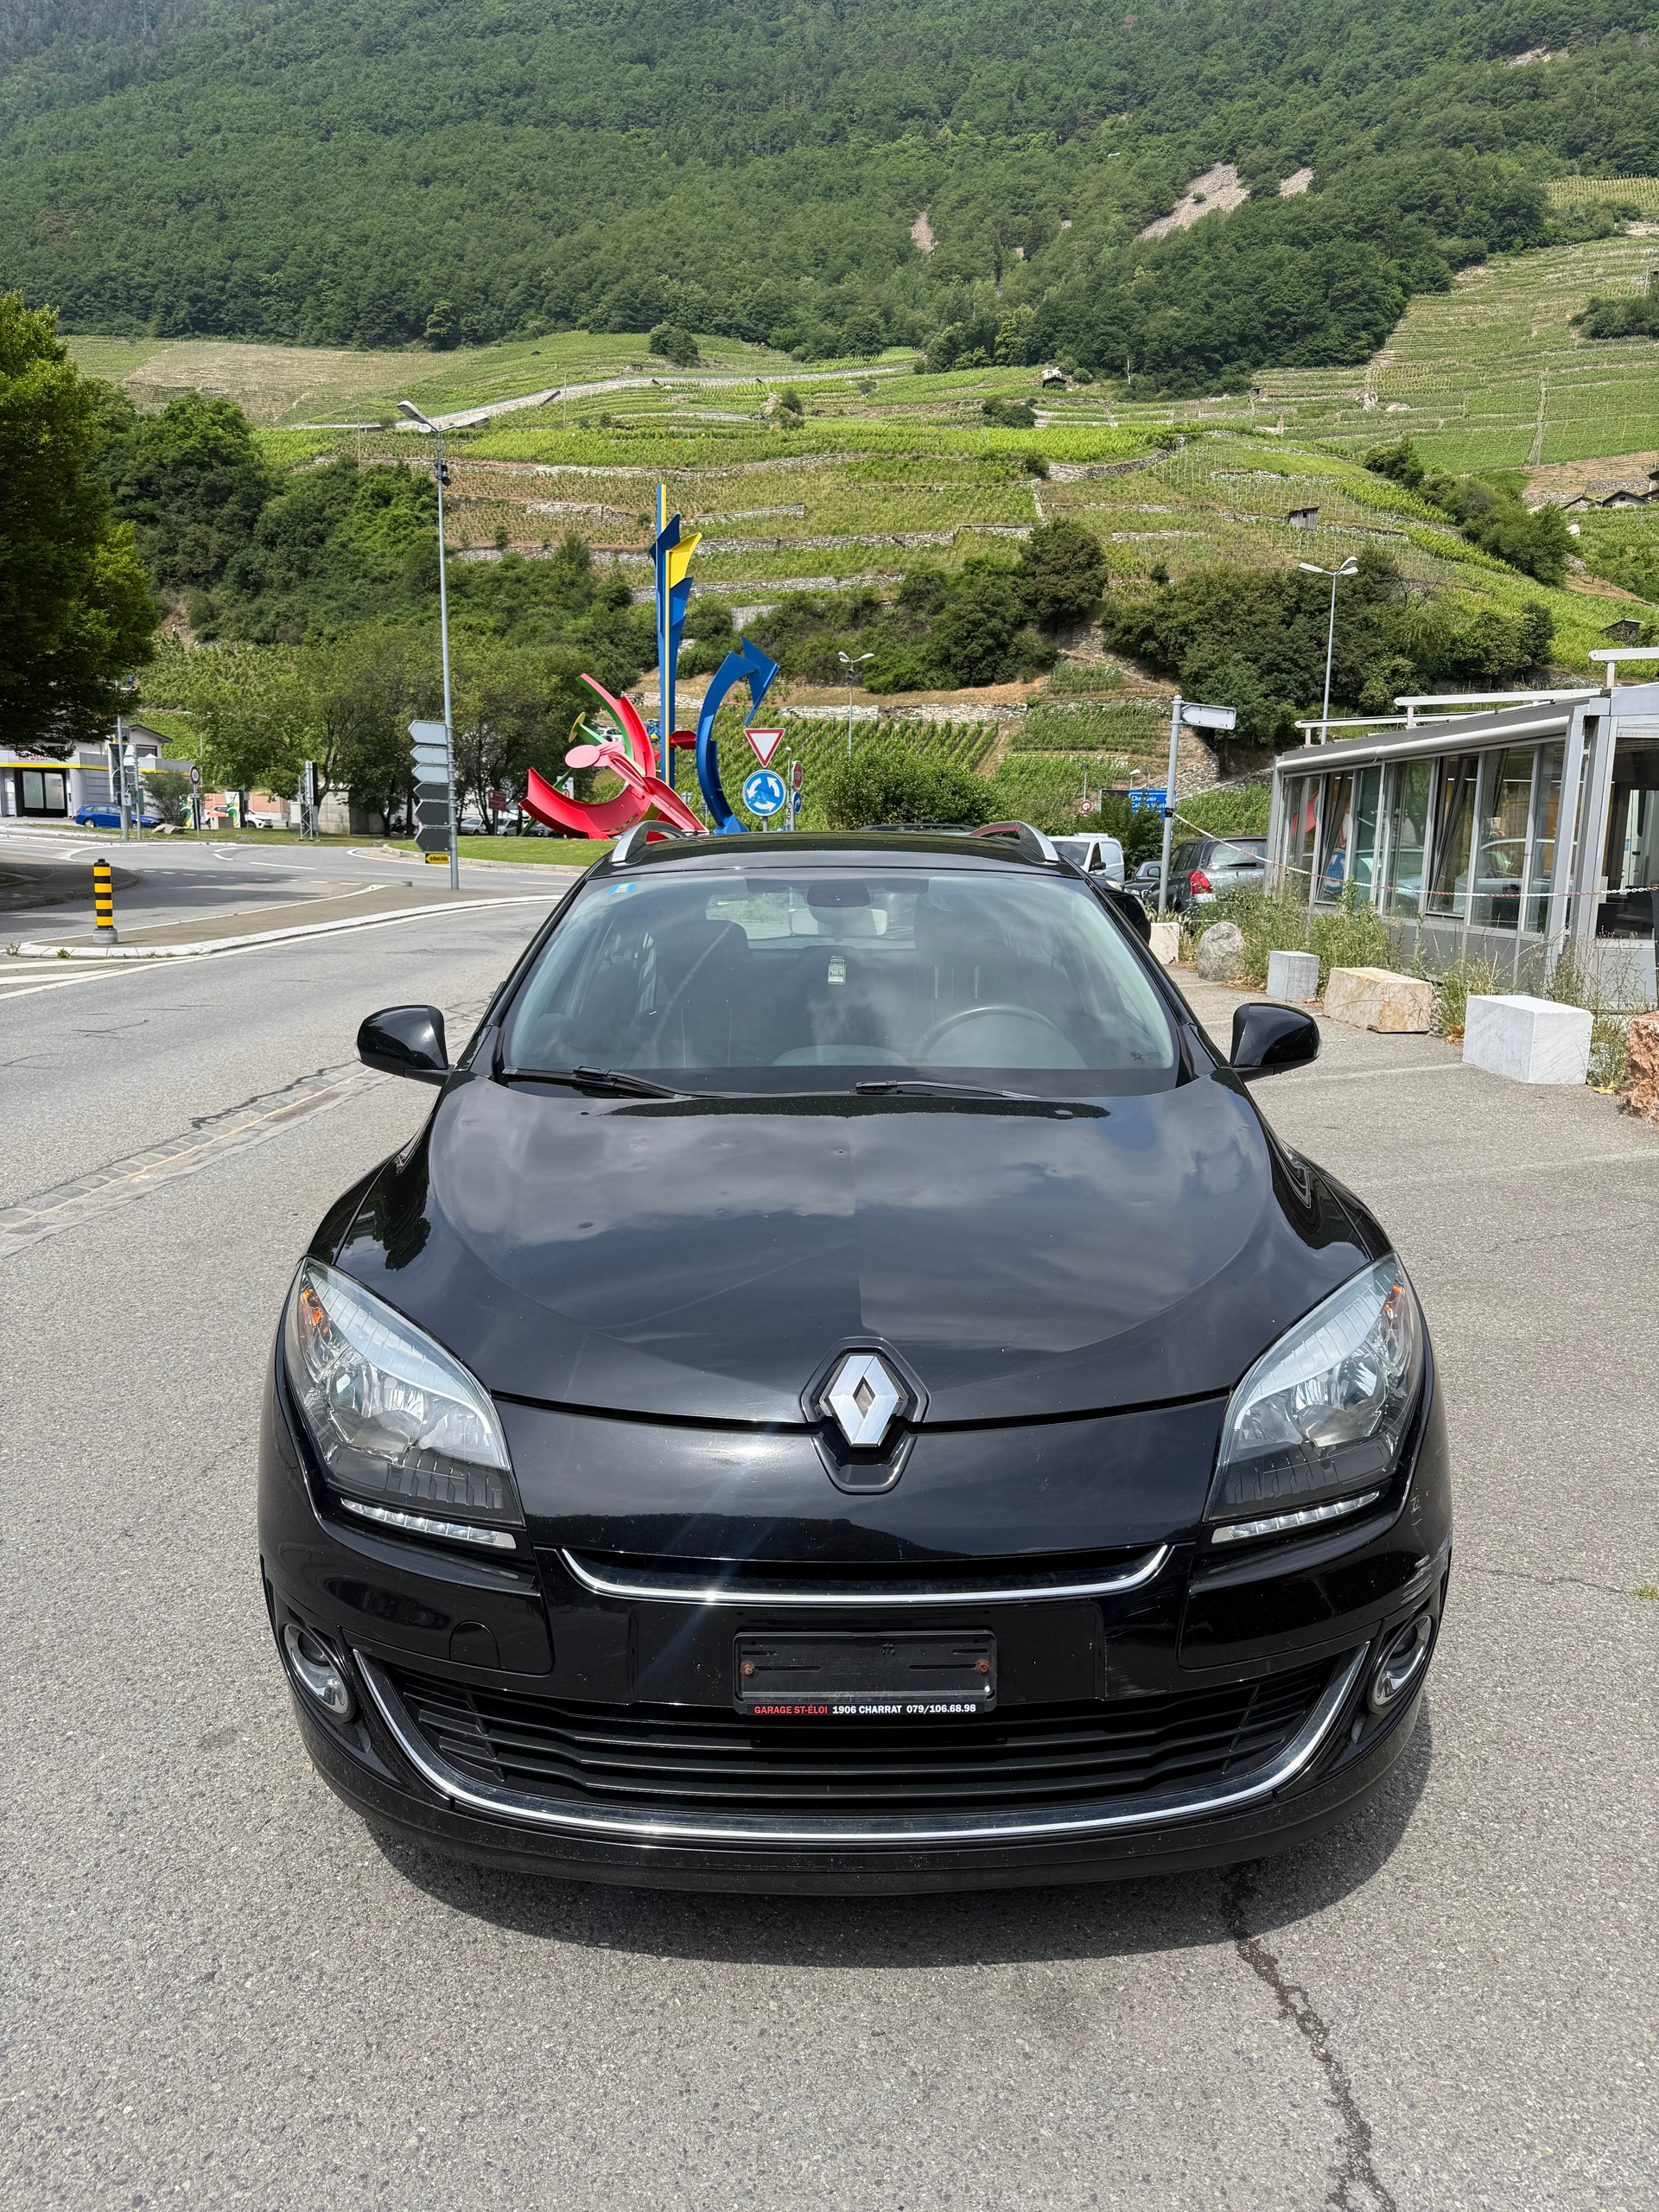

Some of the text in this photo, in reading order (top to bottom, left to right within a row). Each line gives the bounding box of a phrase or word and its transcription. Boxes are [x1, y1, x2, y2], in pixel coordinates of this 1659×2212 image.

[753, 1704, 976, 1714] GARAGE ST-ÉLOI 1906 CHARRAT 079/106.68.98
